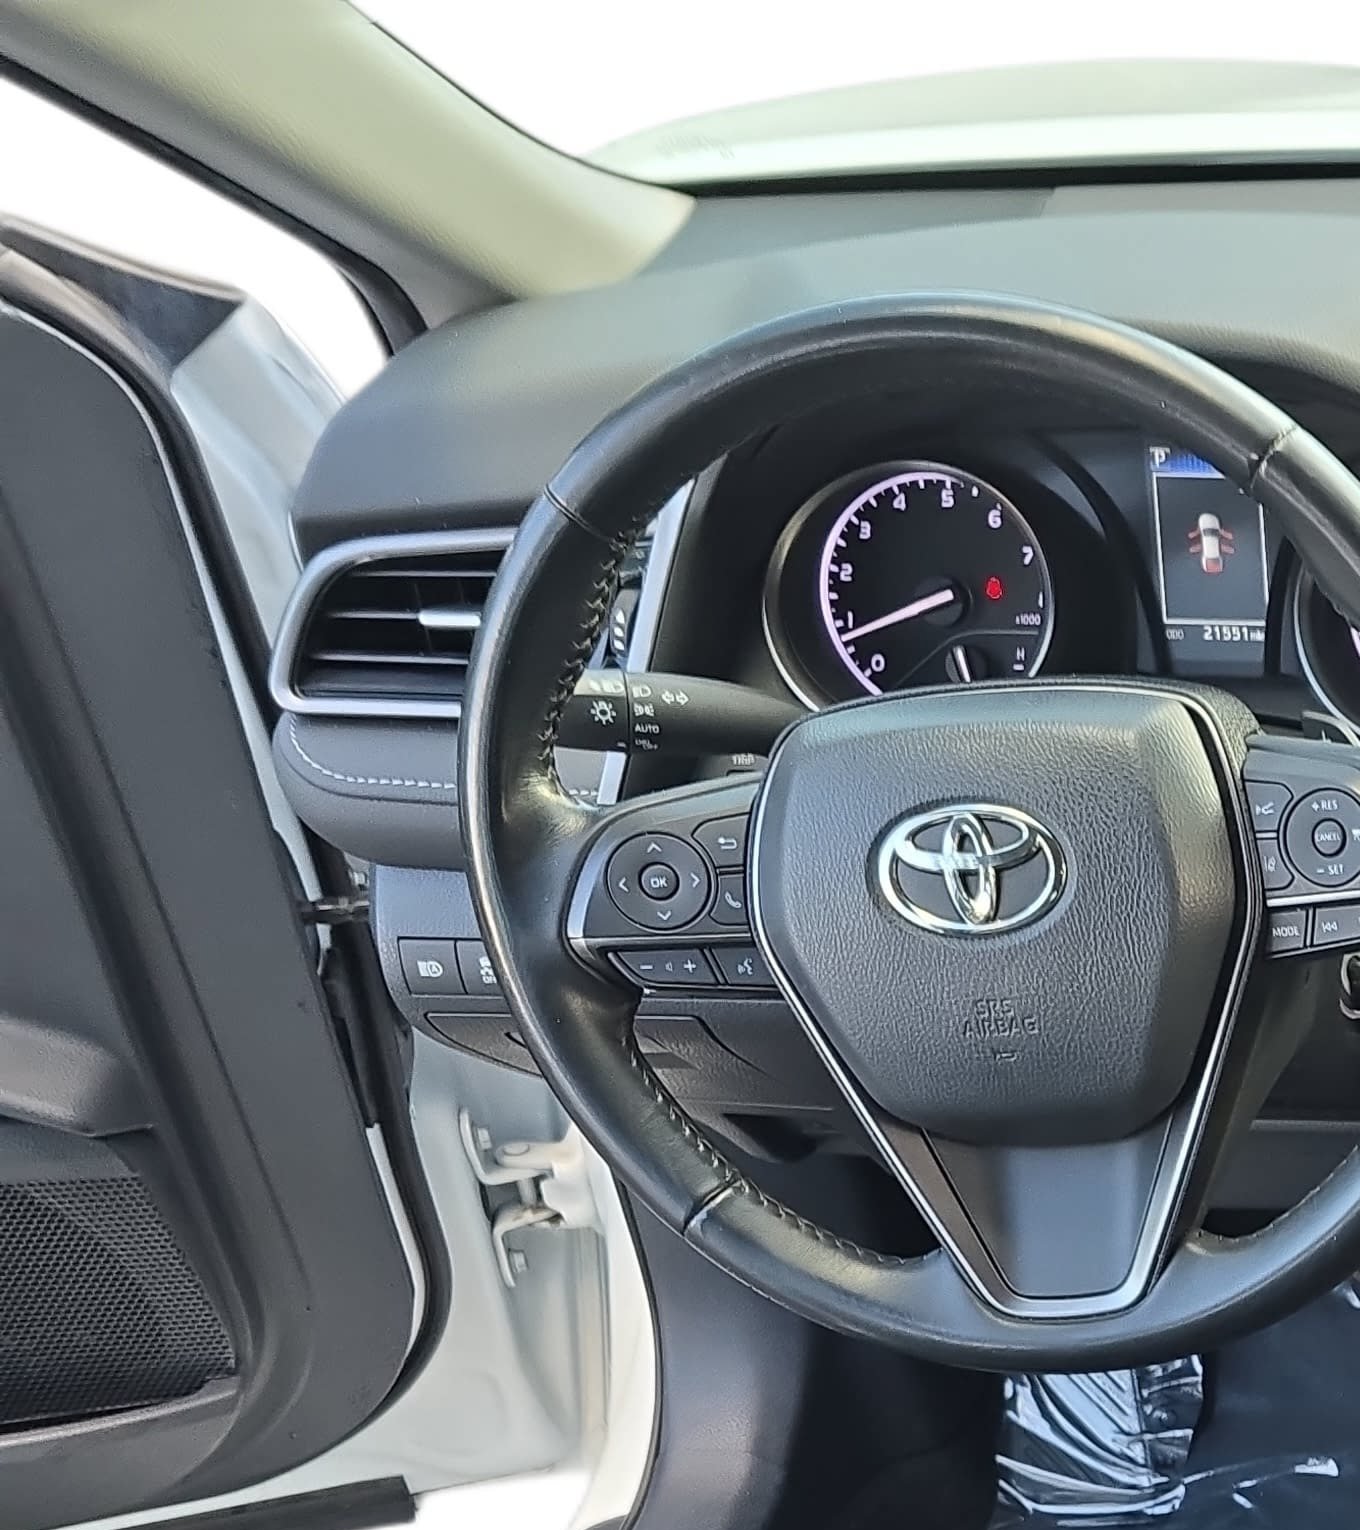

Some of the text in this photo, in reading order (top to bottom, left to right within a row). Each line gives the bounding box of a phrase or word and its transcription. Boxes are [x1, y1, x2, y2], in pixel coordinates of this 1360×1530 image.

[893, 493, 906, 511] 4
[940, 490, 955, 509] 5
[987, 508, 1002, 529] 6
[858, 522, 871, 540] 3
[1021, 545, 1034, 566] 7
[839, 563, 853, 582] 2
[870, 654, 886, 673] 0
[634, 724, 660, 734] AUTO
[1328, 864, 1344, 876] SET
[650, 876, 668, 888] OK
[1272, 926, 1300, 938] MODE
[975, 998, 1014, 1019] SRS
[962, 1016, 1041, 1039] AIRBAG
